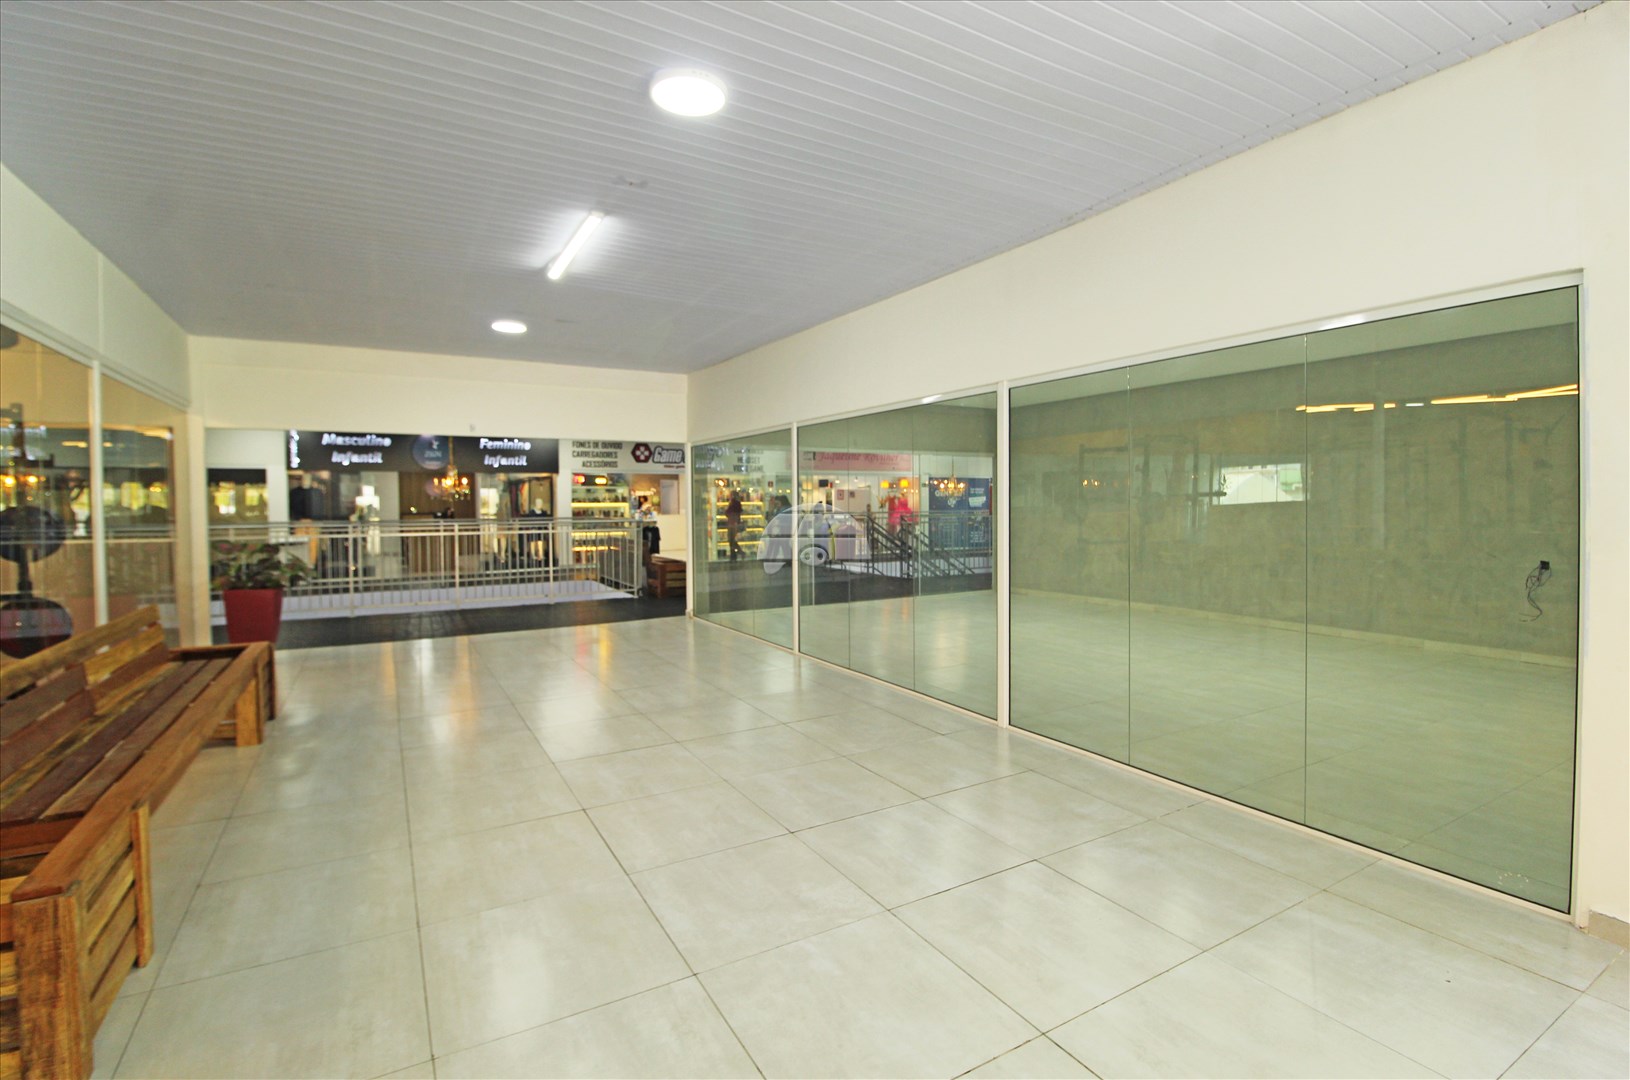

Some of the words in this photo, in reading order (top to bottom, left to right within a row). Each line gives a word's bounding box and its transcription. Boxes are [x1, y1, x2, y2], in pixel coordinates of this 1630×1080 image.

[322, 433, 391, 447] Masculino
[479, 437, 531, 450] Feminino
[572, 441, 591, 449] FONES
[592, 441, 600, 449] DE
[601, 442, 623, 450] OUVIDO
[572, 450, 618, 459] CARREGADORES
[653, 446, 684, 464] Game
[582, 459, 618, 468] ACESSÓRIOS
